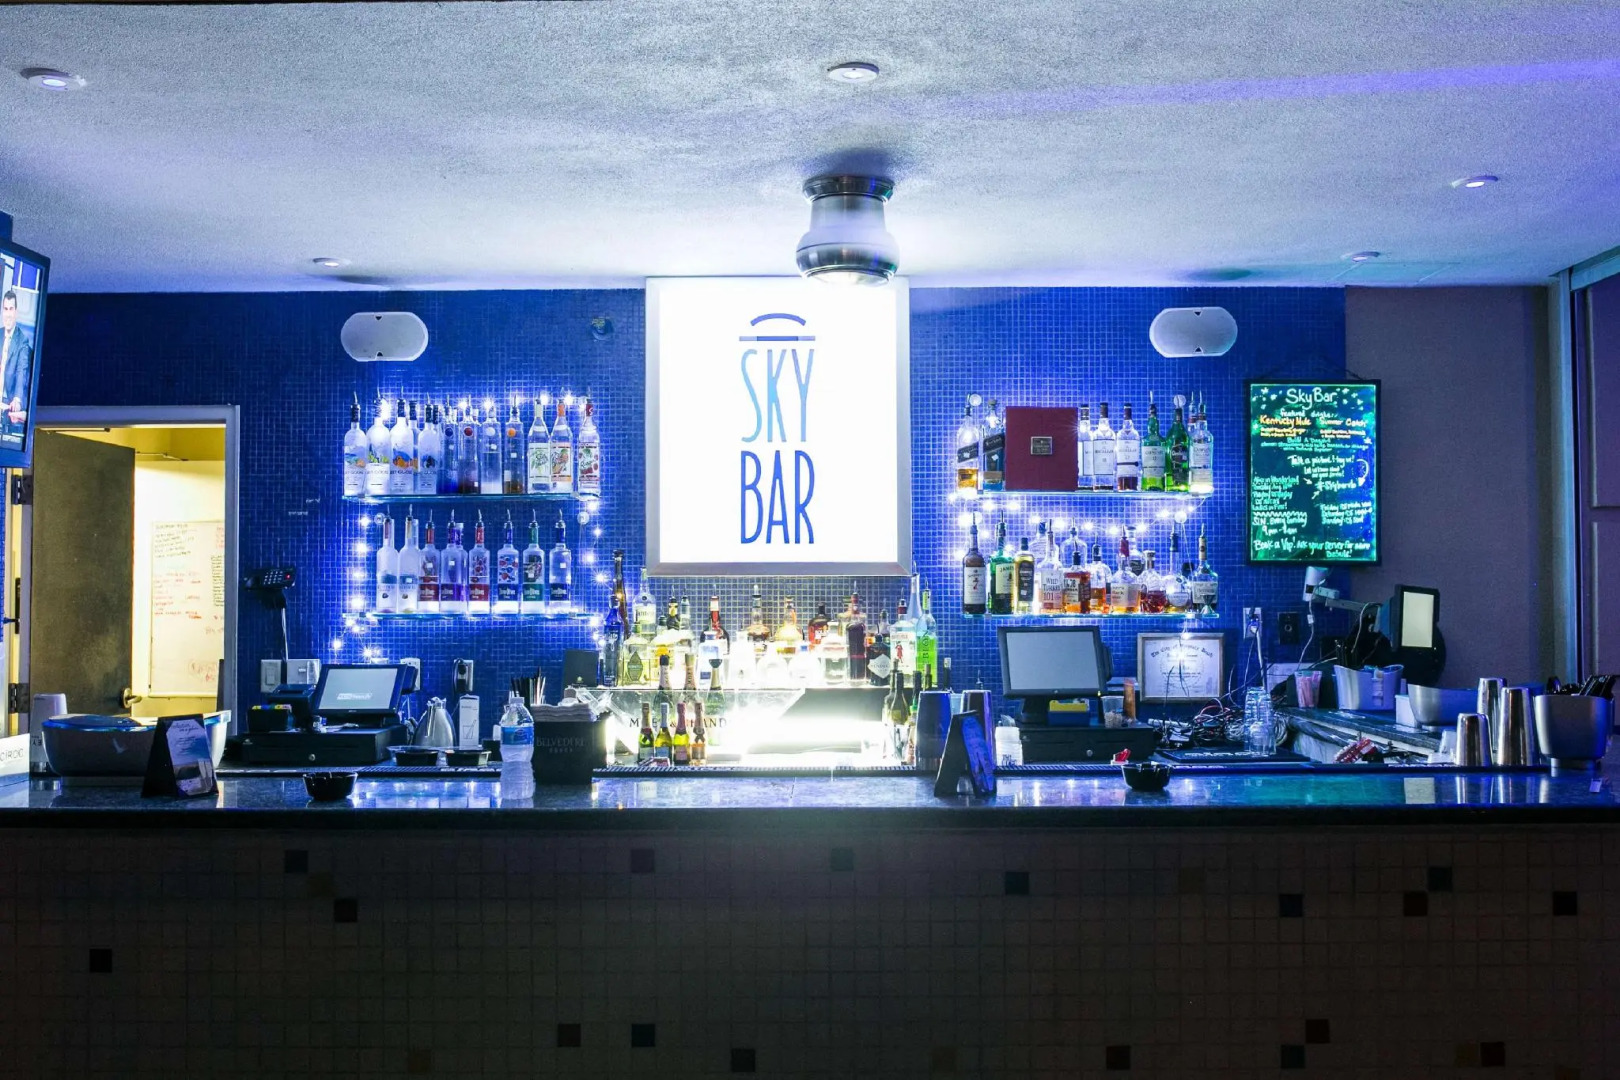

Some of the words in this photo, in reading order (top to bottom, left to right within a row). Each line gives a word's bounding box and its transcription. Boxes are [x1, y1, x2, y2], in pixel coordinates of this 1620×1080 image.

[741, 349, 815, 442] SKY
[1286, 388, 1312, 410] Sky
[1312, 387, 1337, 402] Bar
[741, 450, 815, 544] BAR
